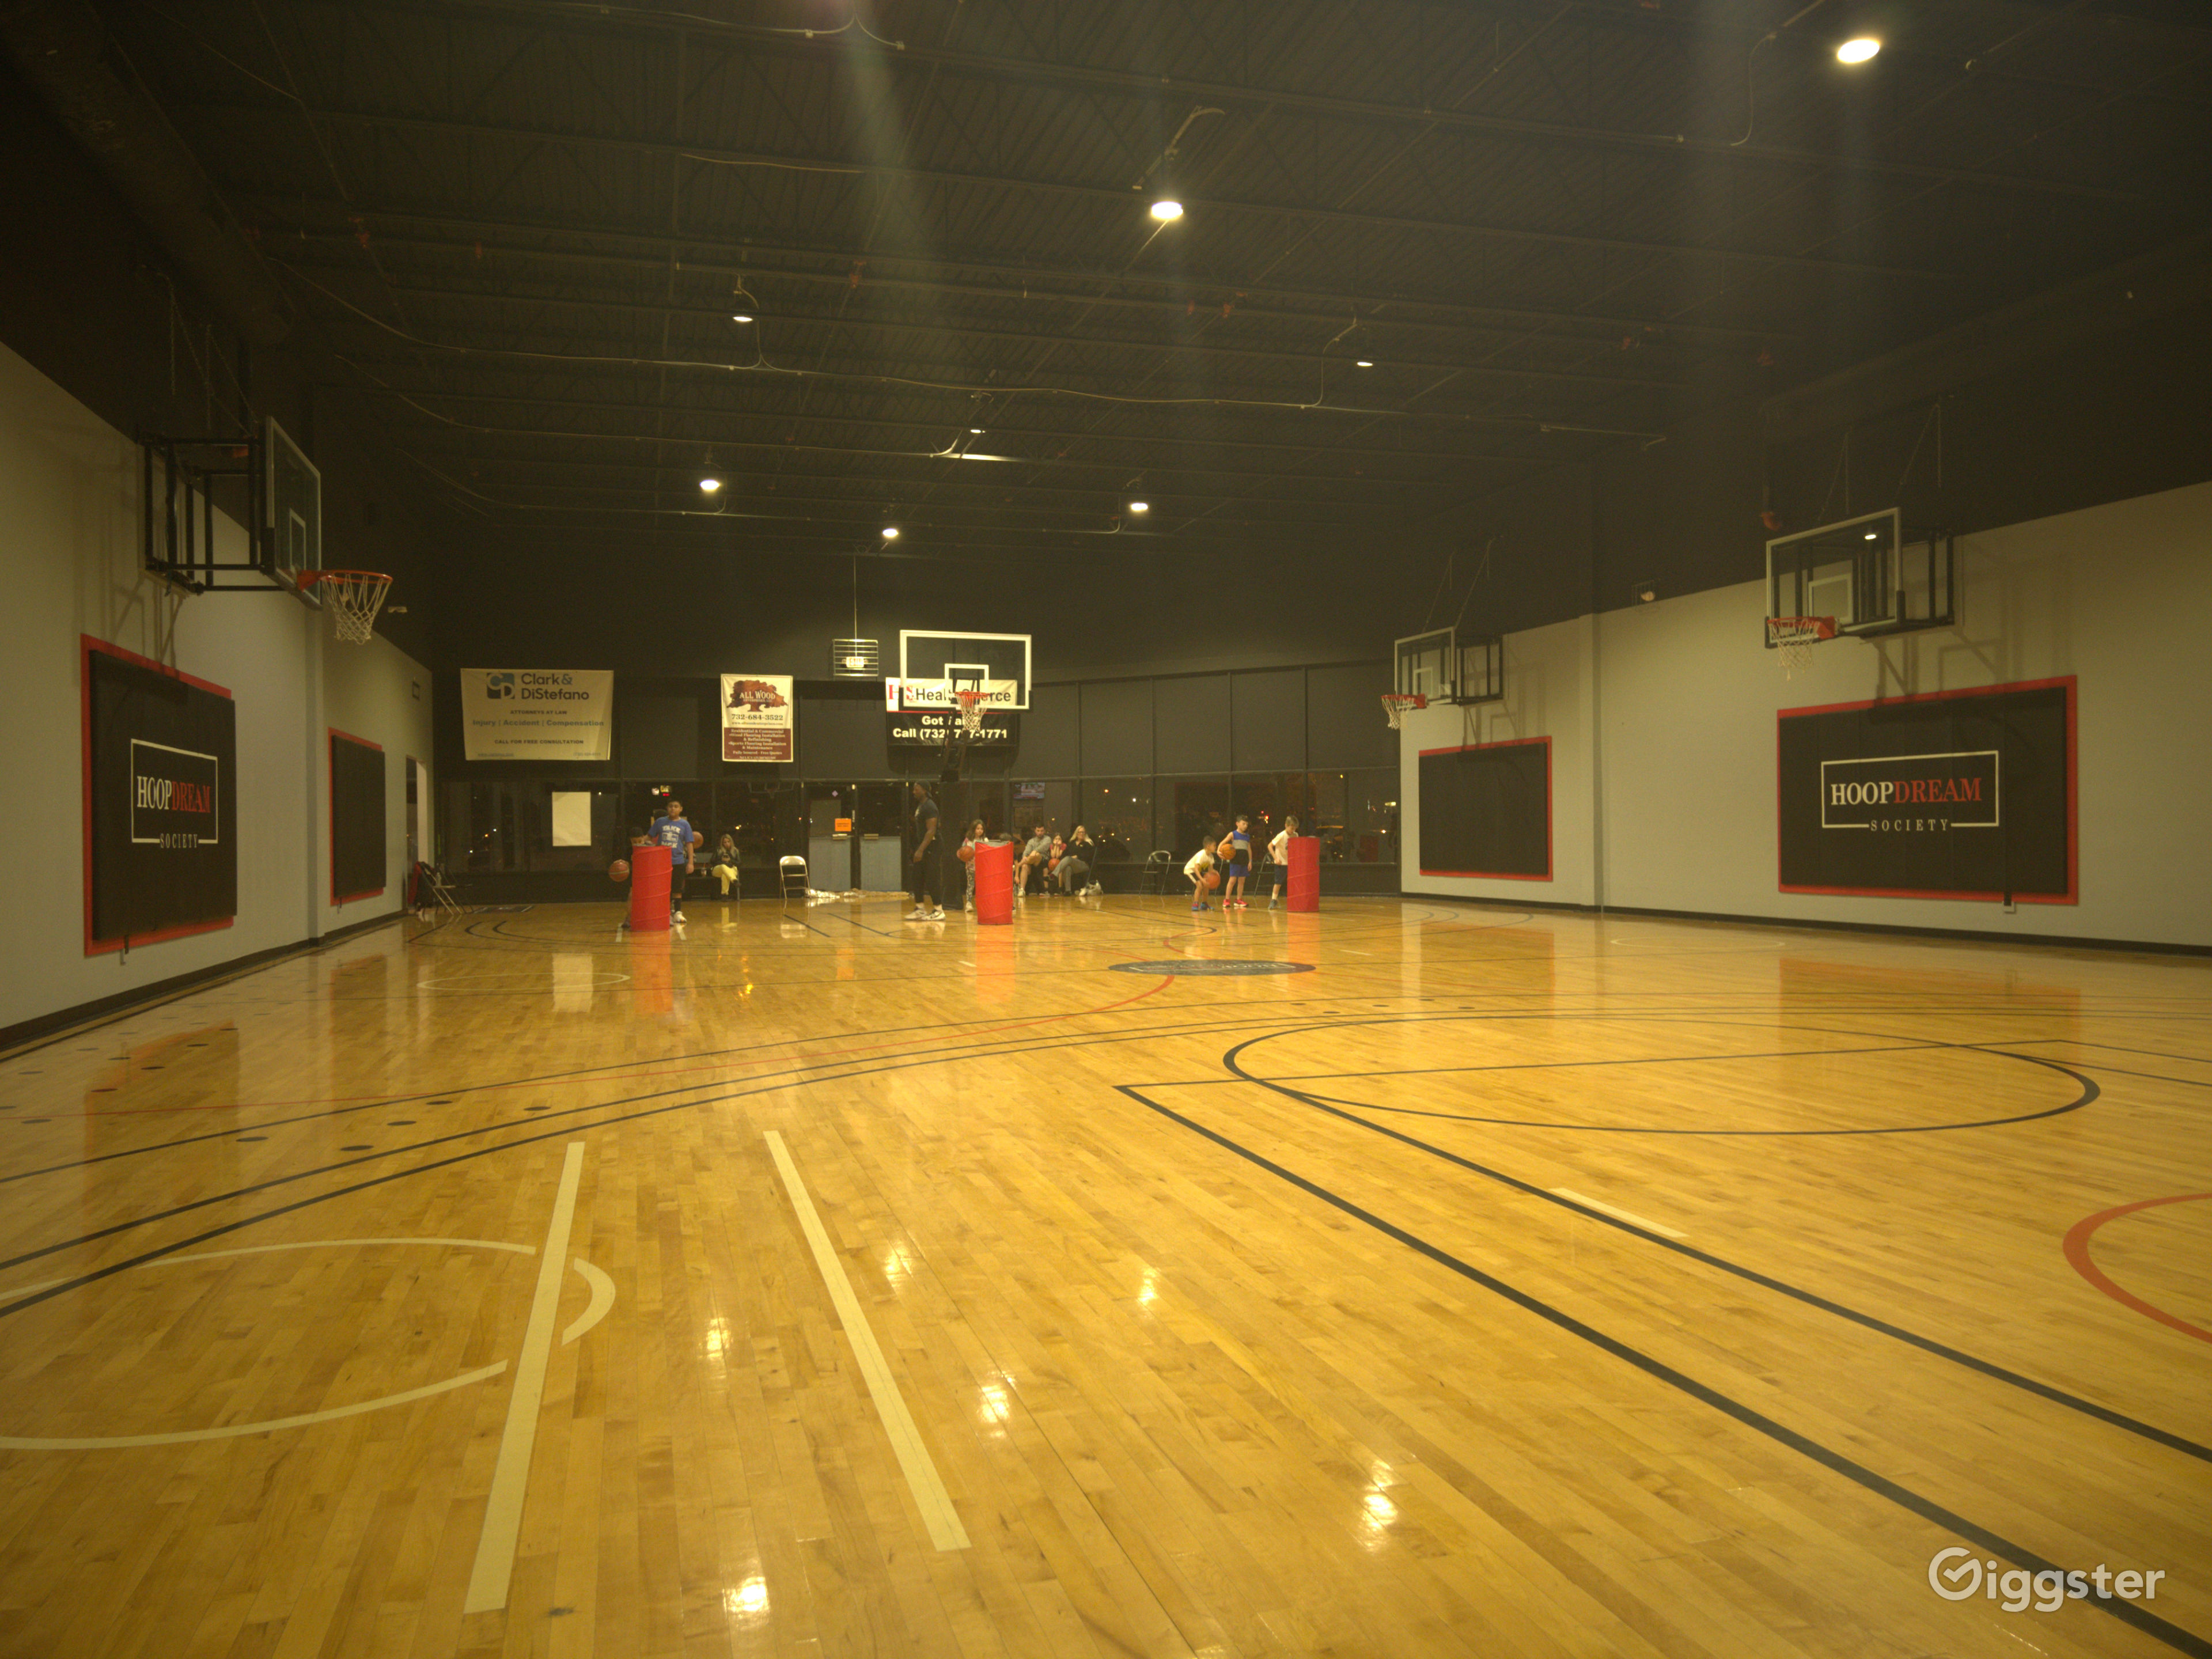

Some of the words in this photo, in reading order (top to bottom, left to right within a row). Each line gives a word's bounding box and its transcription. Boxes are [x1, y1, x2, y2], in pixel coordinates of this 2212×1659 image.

[521, 673, 560, 685] Clark
[562, 673, 573, 685] &
[521, 688, 589, 700] DiStefano
[740, 691, 753, 699] ALL
[755, 690, 776, 700] WOOD
[922, 715, 944, 725] Got
[893, 728, 916, 738] Call
[954, 729, 1007, 738] 77-1771
[137, 775, 211, 813] HOOPDREAM
[1831, 778, 1982, 805] HOOPDREAM
[1871, 819, 1948, 831] SOCIETY
[160, 834, 198, 849] SOCIETY
